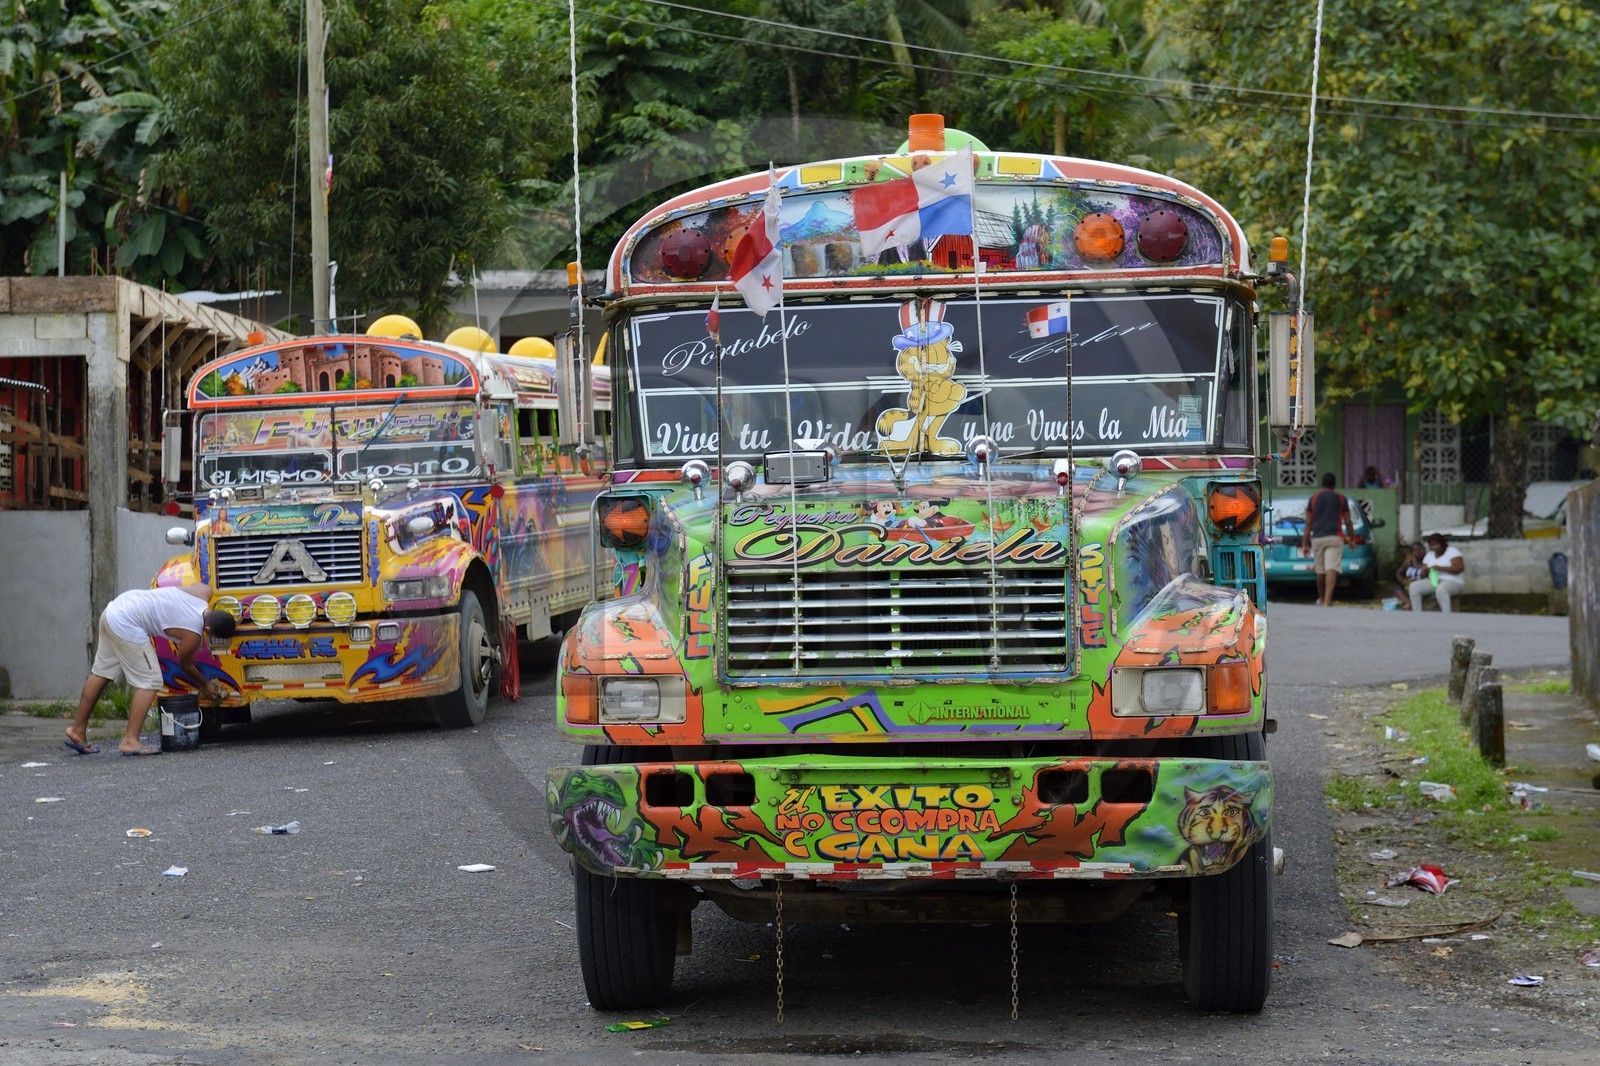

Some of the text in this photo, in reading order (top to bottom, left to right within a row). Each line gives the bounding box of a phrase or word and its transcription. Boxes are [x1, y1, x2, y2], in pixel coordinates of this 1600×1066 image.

[661, 314, 812, 376] Portobelo
[656, 422, 720, 454] Vive
[740, 423, 772, 450] tu
[797, 419, 872, 451] Vida
[990, 421, 1015, 442] no
[1098, 407, 1122, 440] la
[1142, 405, 1190, 438] Mia
[240, 469, 322, 483] MISMO
[729, 504, 858, 531] Pequeña
[724, 523, 1067, 569] Daniela
[685, 552, 714, 660] FULL
[1080, 543, 1107, 648] STYLE
[935, 705, 1030, 719] INTERNATIONAL
[818, 785, 995, 812] EXITO
[775, 812, 825, 832] NO
[856, 808, 1001, 835] COMPRA
[815, 832, 986, 863] GANA
